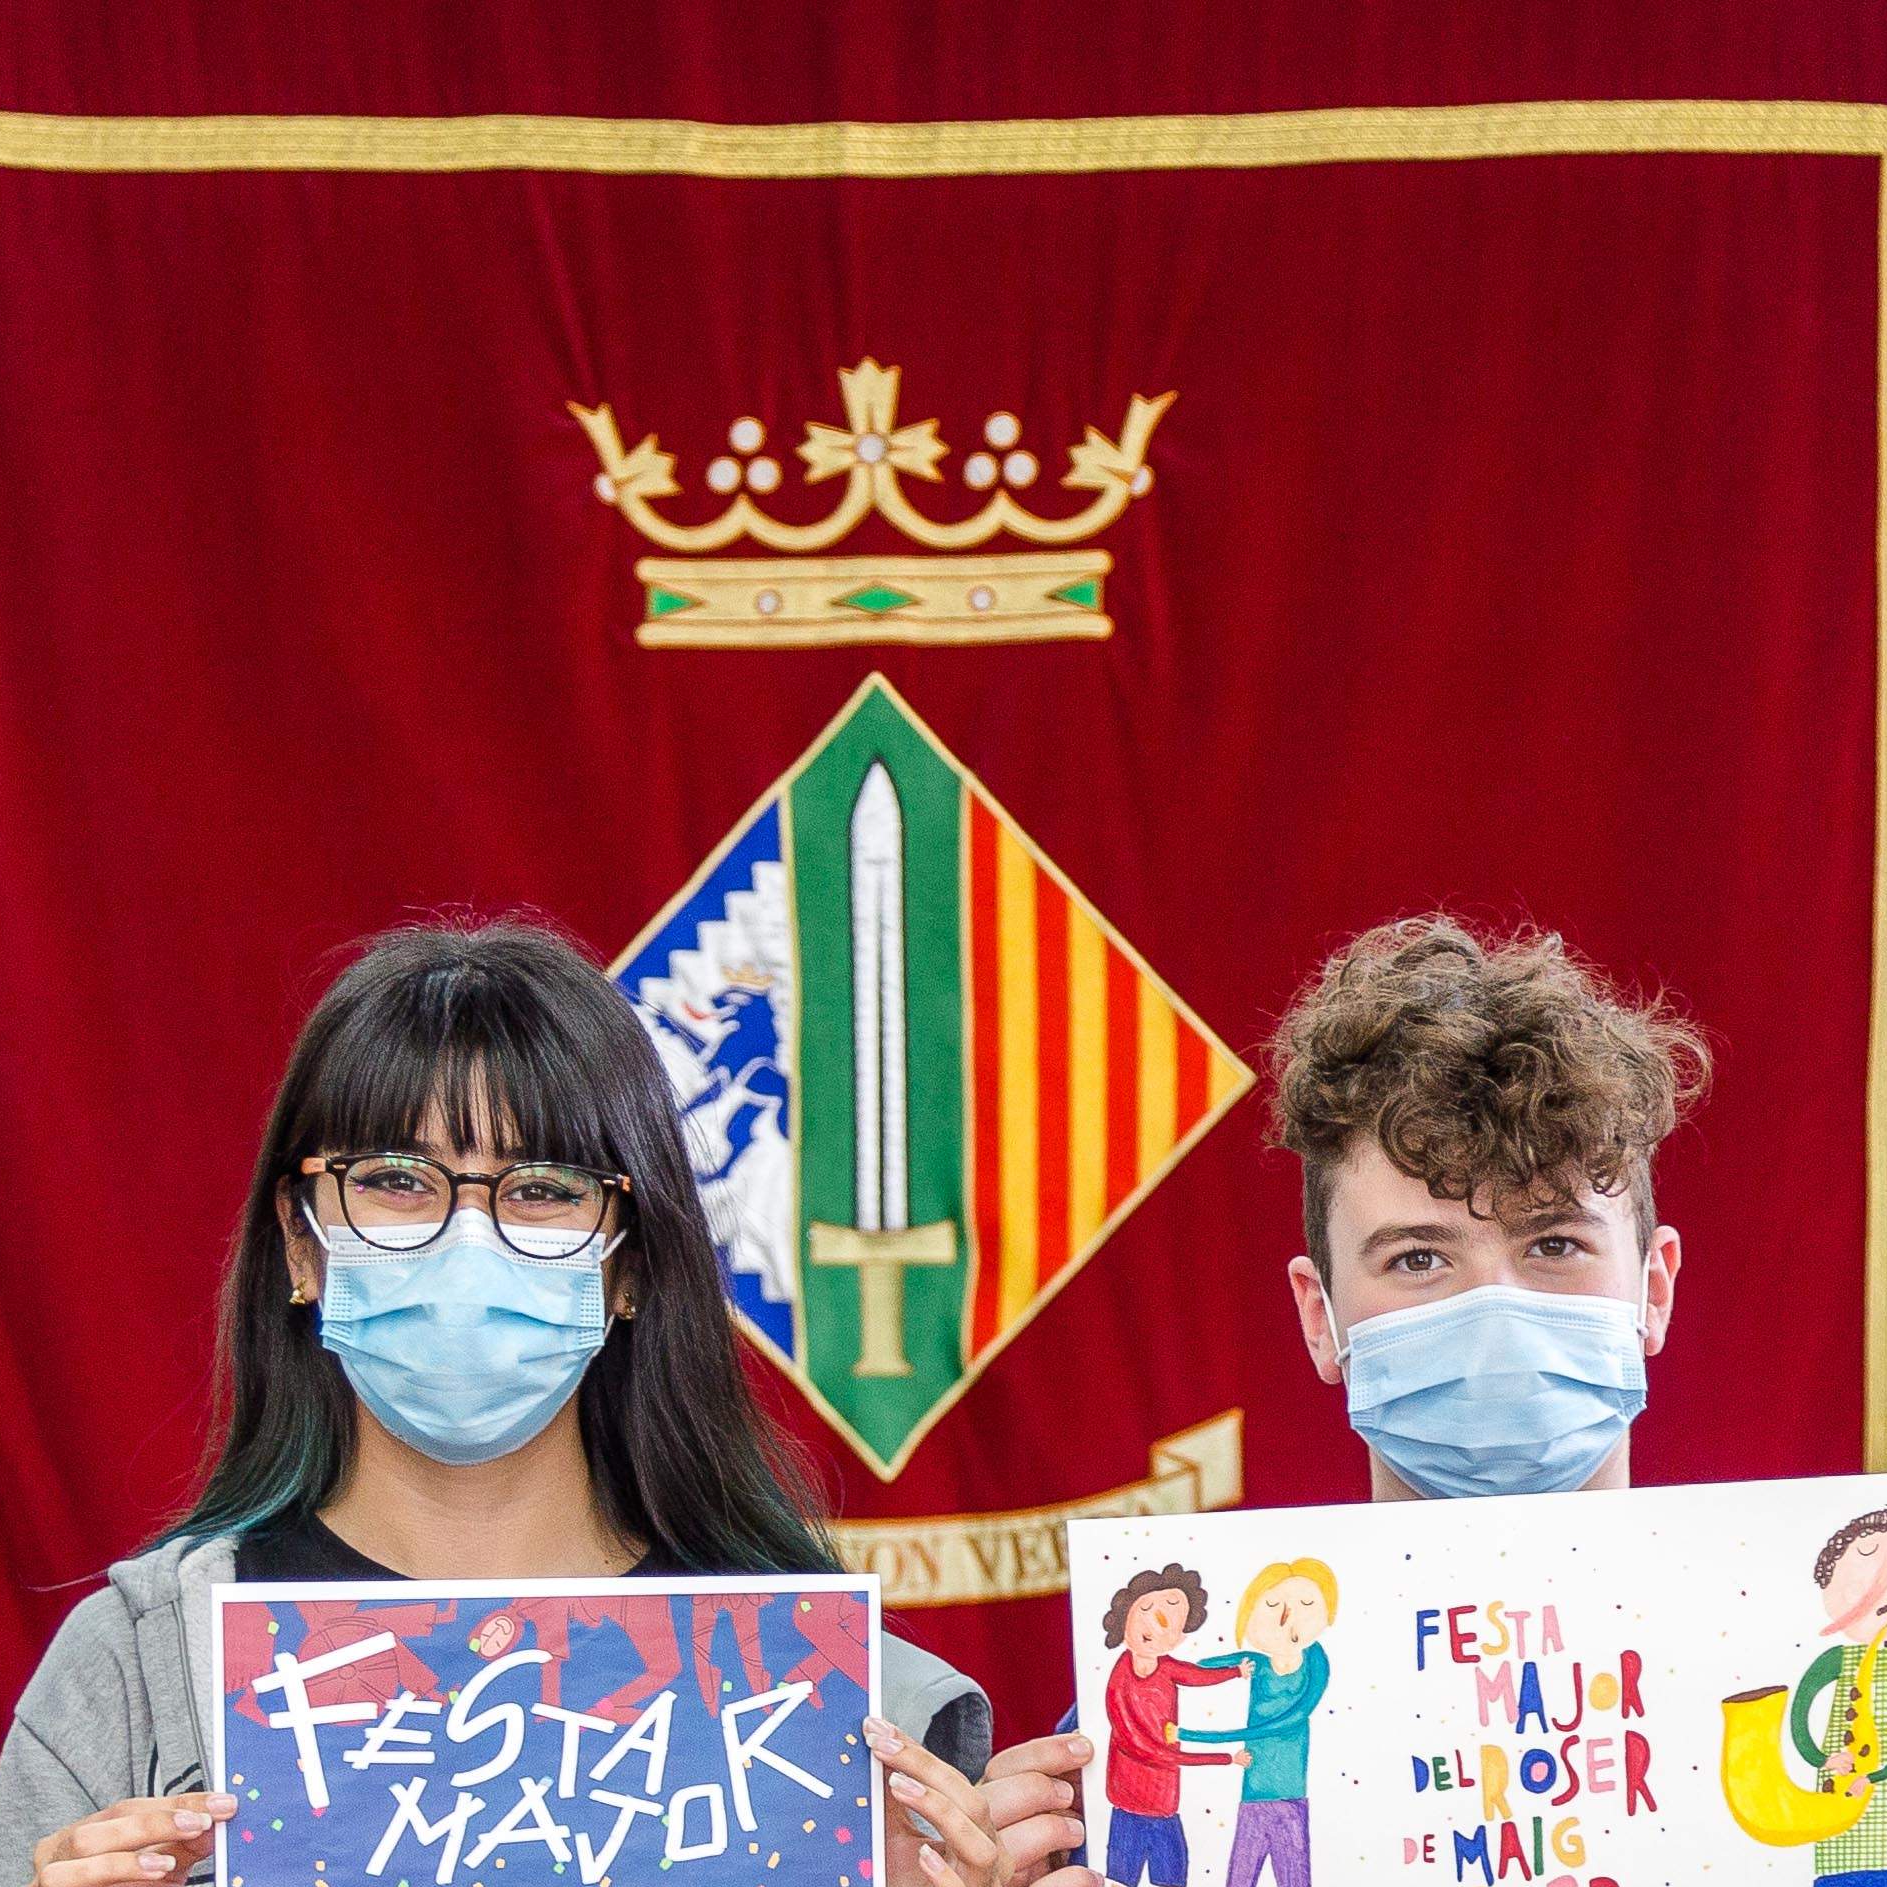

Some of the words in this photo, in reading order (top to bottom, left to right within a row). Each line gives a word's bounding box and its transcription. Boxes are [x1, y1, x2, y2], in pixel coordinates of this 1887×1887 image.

[1416, 1600, 1564, 1671] FESTA
[251, 1631, 677, 1809] FESTA
[1475, 1650, 1645, 1734] MAJOR
[1411, 1749, 1475, 1793] DEL
[1480, 1730, 1657, 1821] ROSER
[1403, 1833, 1436, 1864] DE
[1453, 1816, 1586, 1886] MAIG
